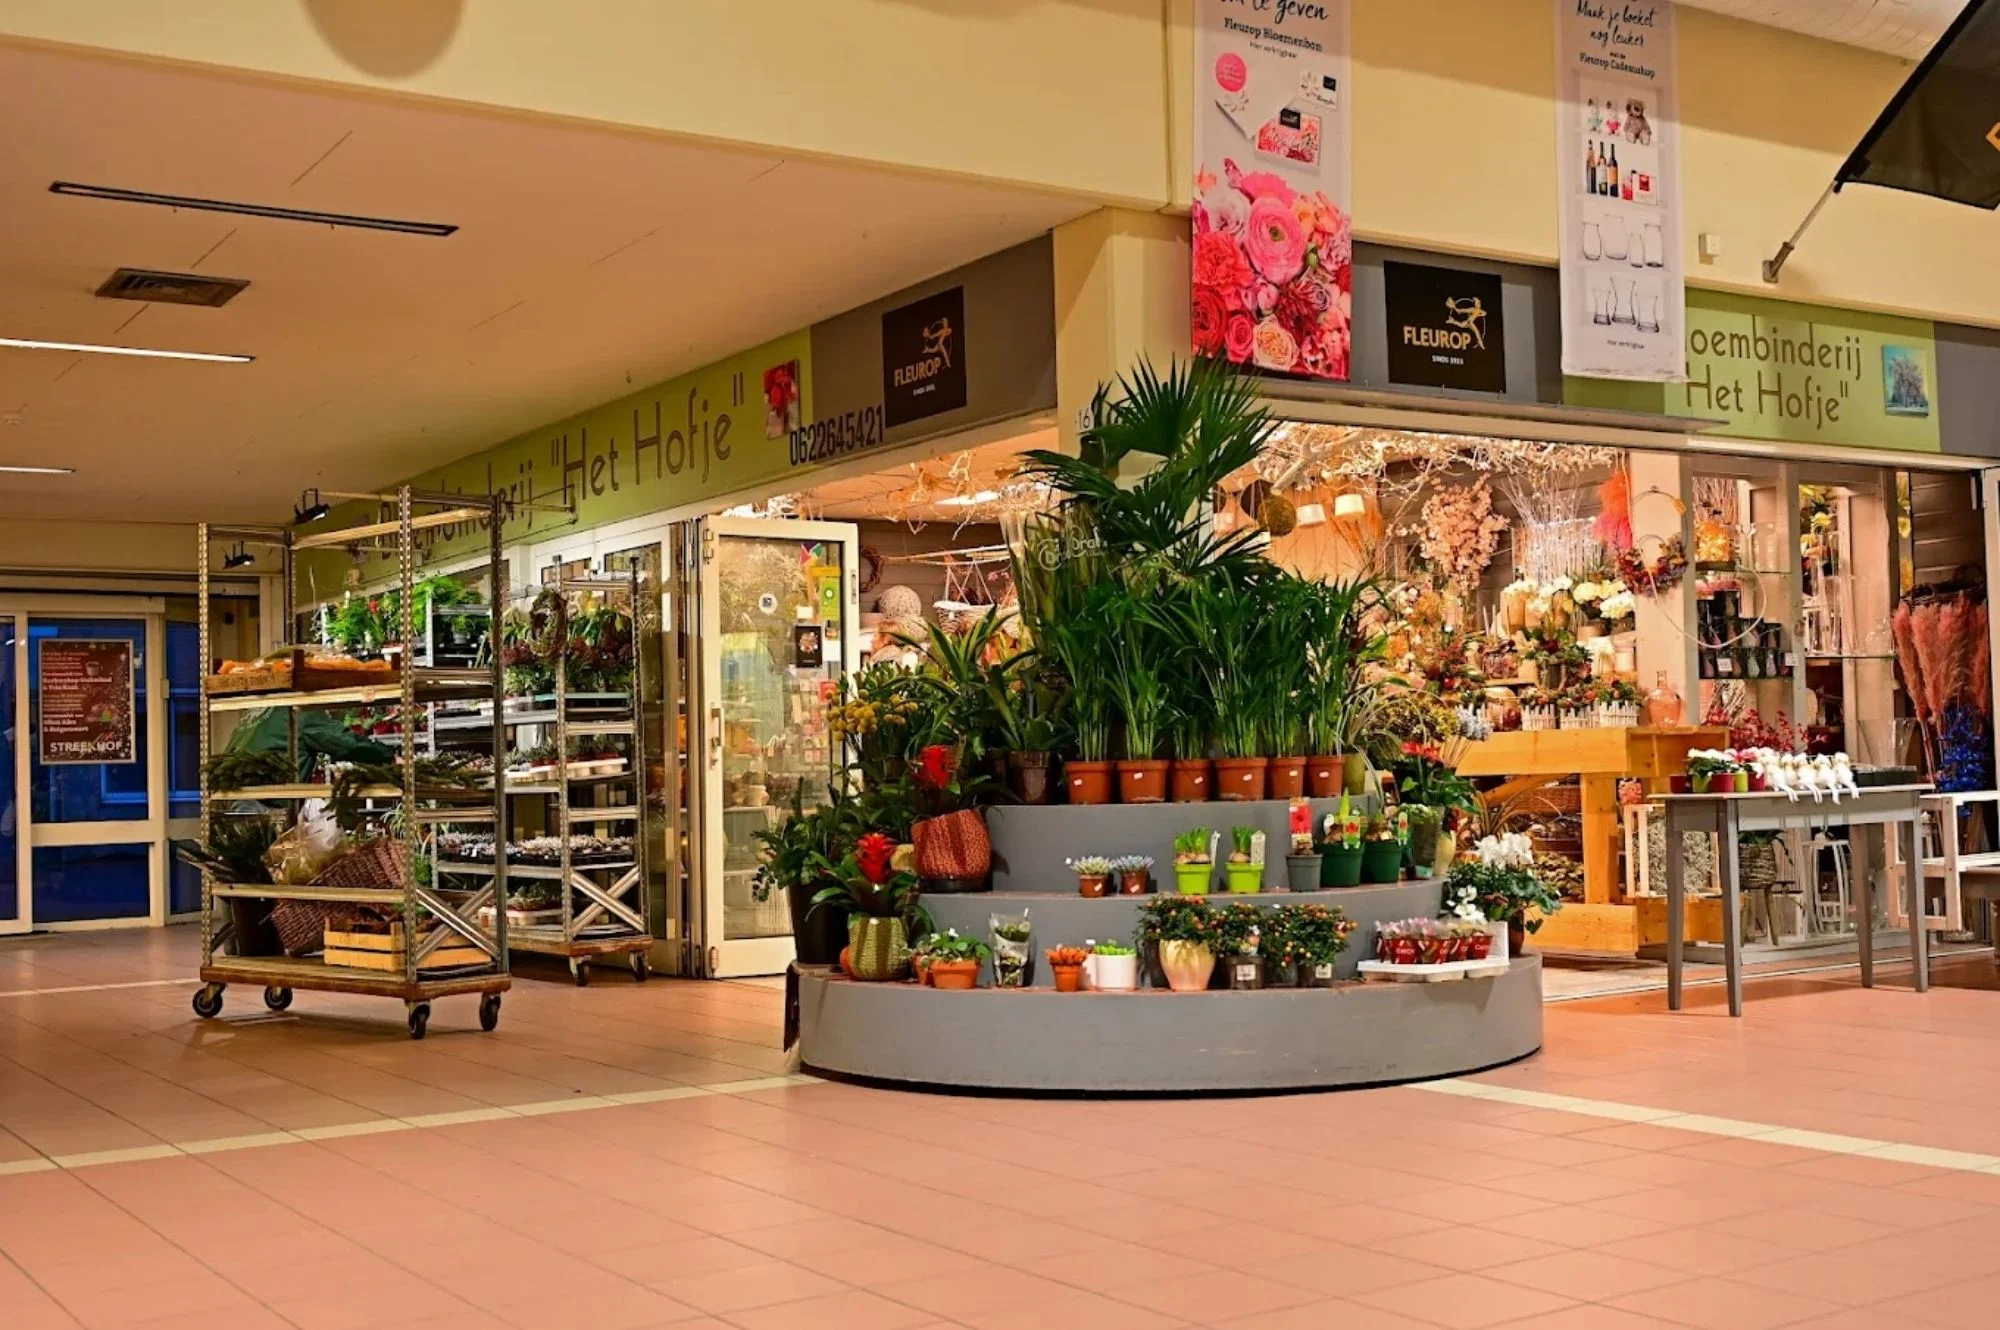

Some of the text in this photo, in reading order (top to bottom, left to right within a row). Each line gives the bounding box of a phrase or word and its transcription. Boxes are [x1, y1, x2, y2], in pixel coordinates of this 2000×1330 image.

[1275, 0, 1329, 24] geven
[1224, 17, 1322, 51] Fleurop Bloemenbon
[1590, 31, 1608, 48] nog
[1579, 52, 1609, 70] Fleurop
[1403, 325, 1471, 350] FLEUROP
[1686, 314, 1861, 381] oembinderij
[894, 357, 941, 387] FLEUROP
[1757, 370, 1848, 430] Hofje"
[551, 427, 619, 504] "Het
[633, 371, 744, 483] Hofje"
[789, 404, 884, 466] 0622645421
[50, 741, 123, 753] STREEKHOF
